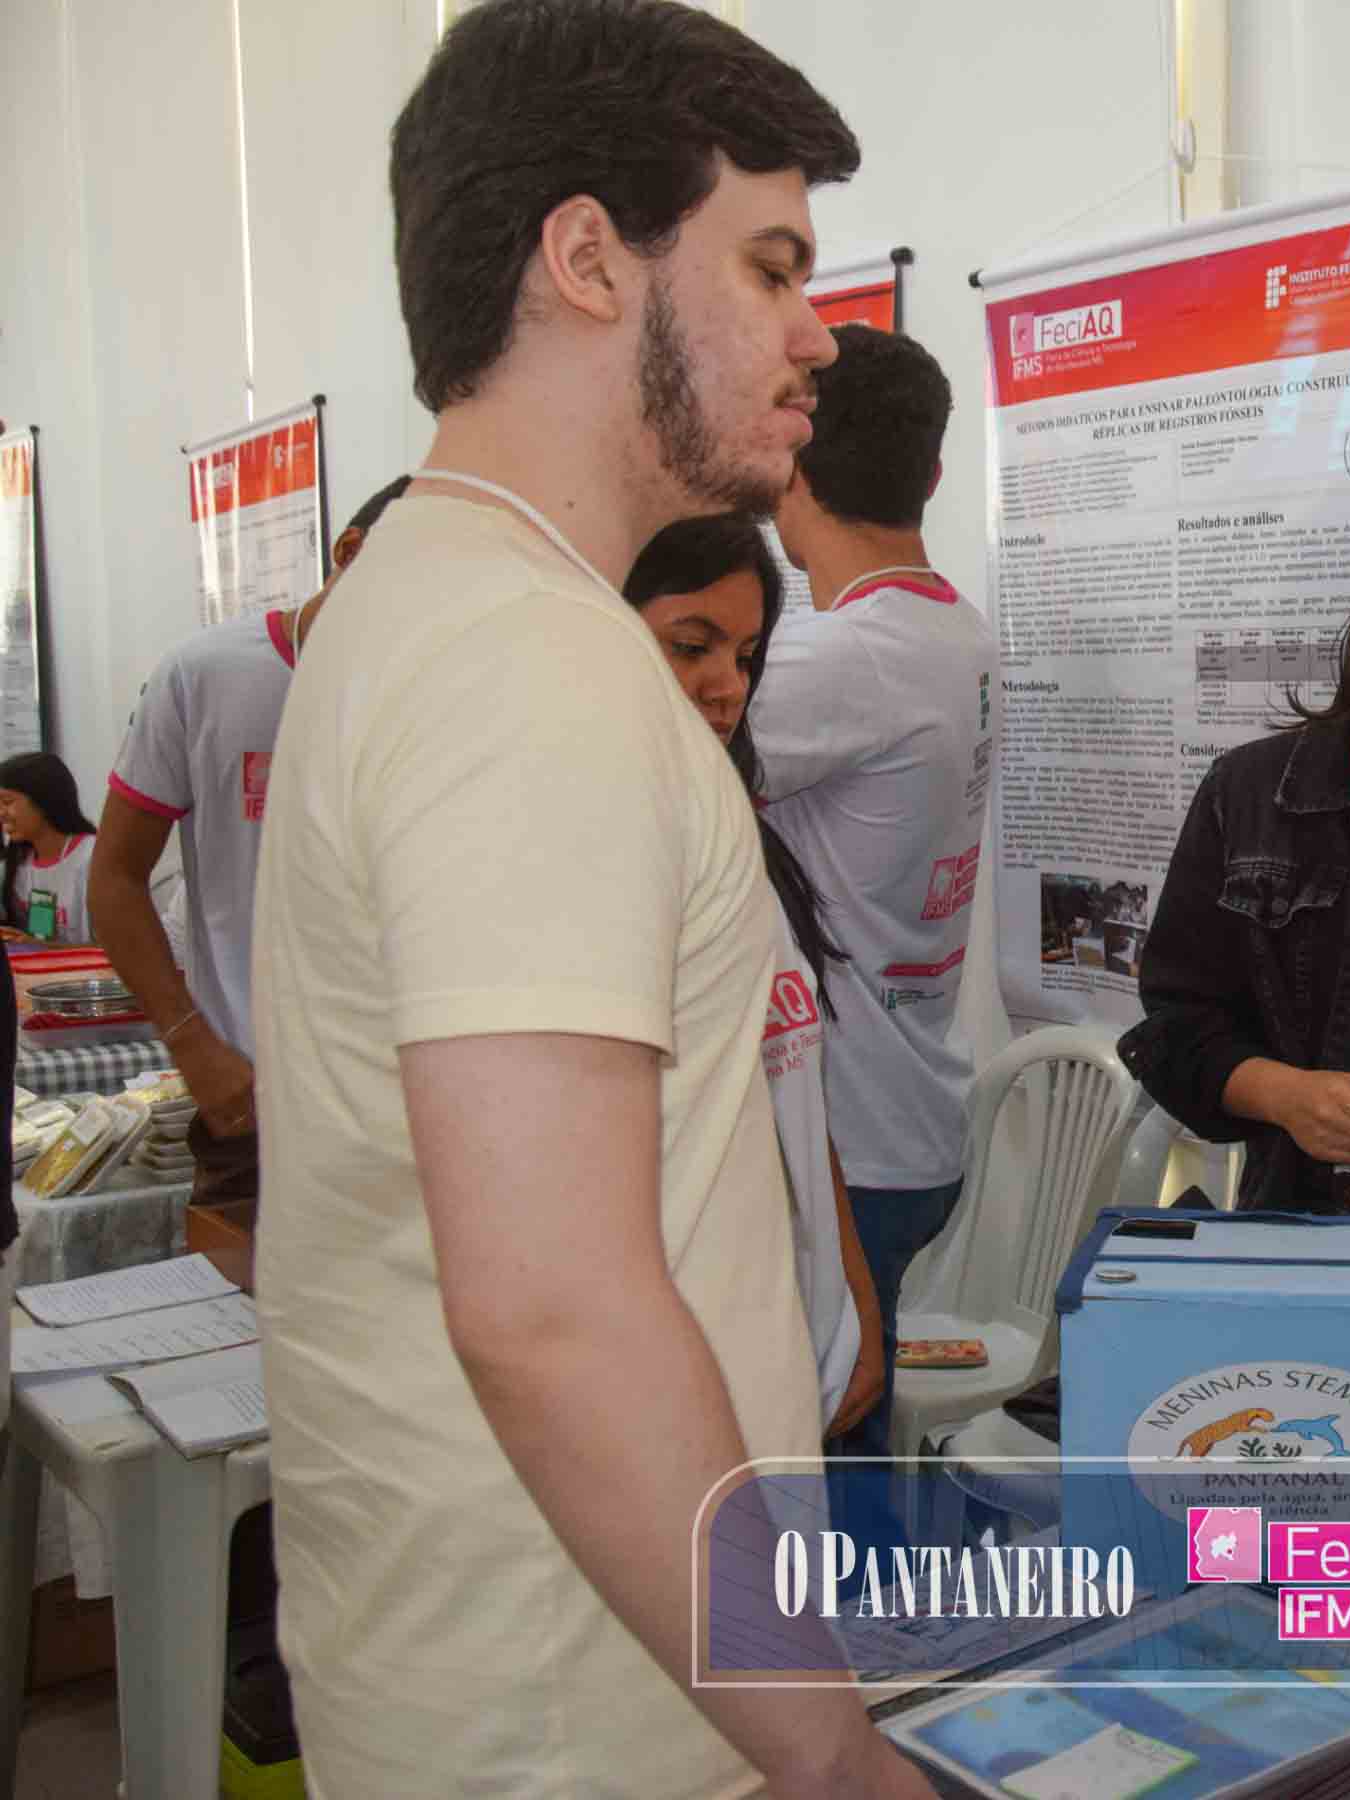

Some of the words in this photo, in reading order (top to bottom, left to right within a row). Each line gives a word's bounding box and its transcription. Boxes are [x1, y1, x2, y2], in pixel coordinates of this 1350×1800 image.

[1041, 306, 1115, 348] FeciAQ
[1013, 356, 1042, 382] IFMS
[1109, 405, 1136, 421] PARA
[1138, 398, 1184, 418] ENSINAR
[1143, 419, 1157, 433] DE
[1159, 411, 1218, 432] REGISTROS
[1178, 513, 1231, 532] Resultados
[1242, 511, 1285, 527] análises
[1146, 1369, 1273, 1431] MENINAS
[1201, 1472, 1345, 1488] PANTANAL
